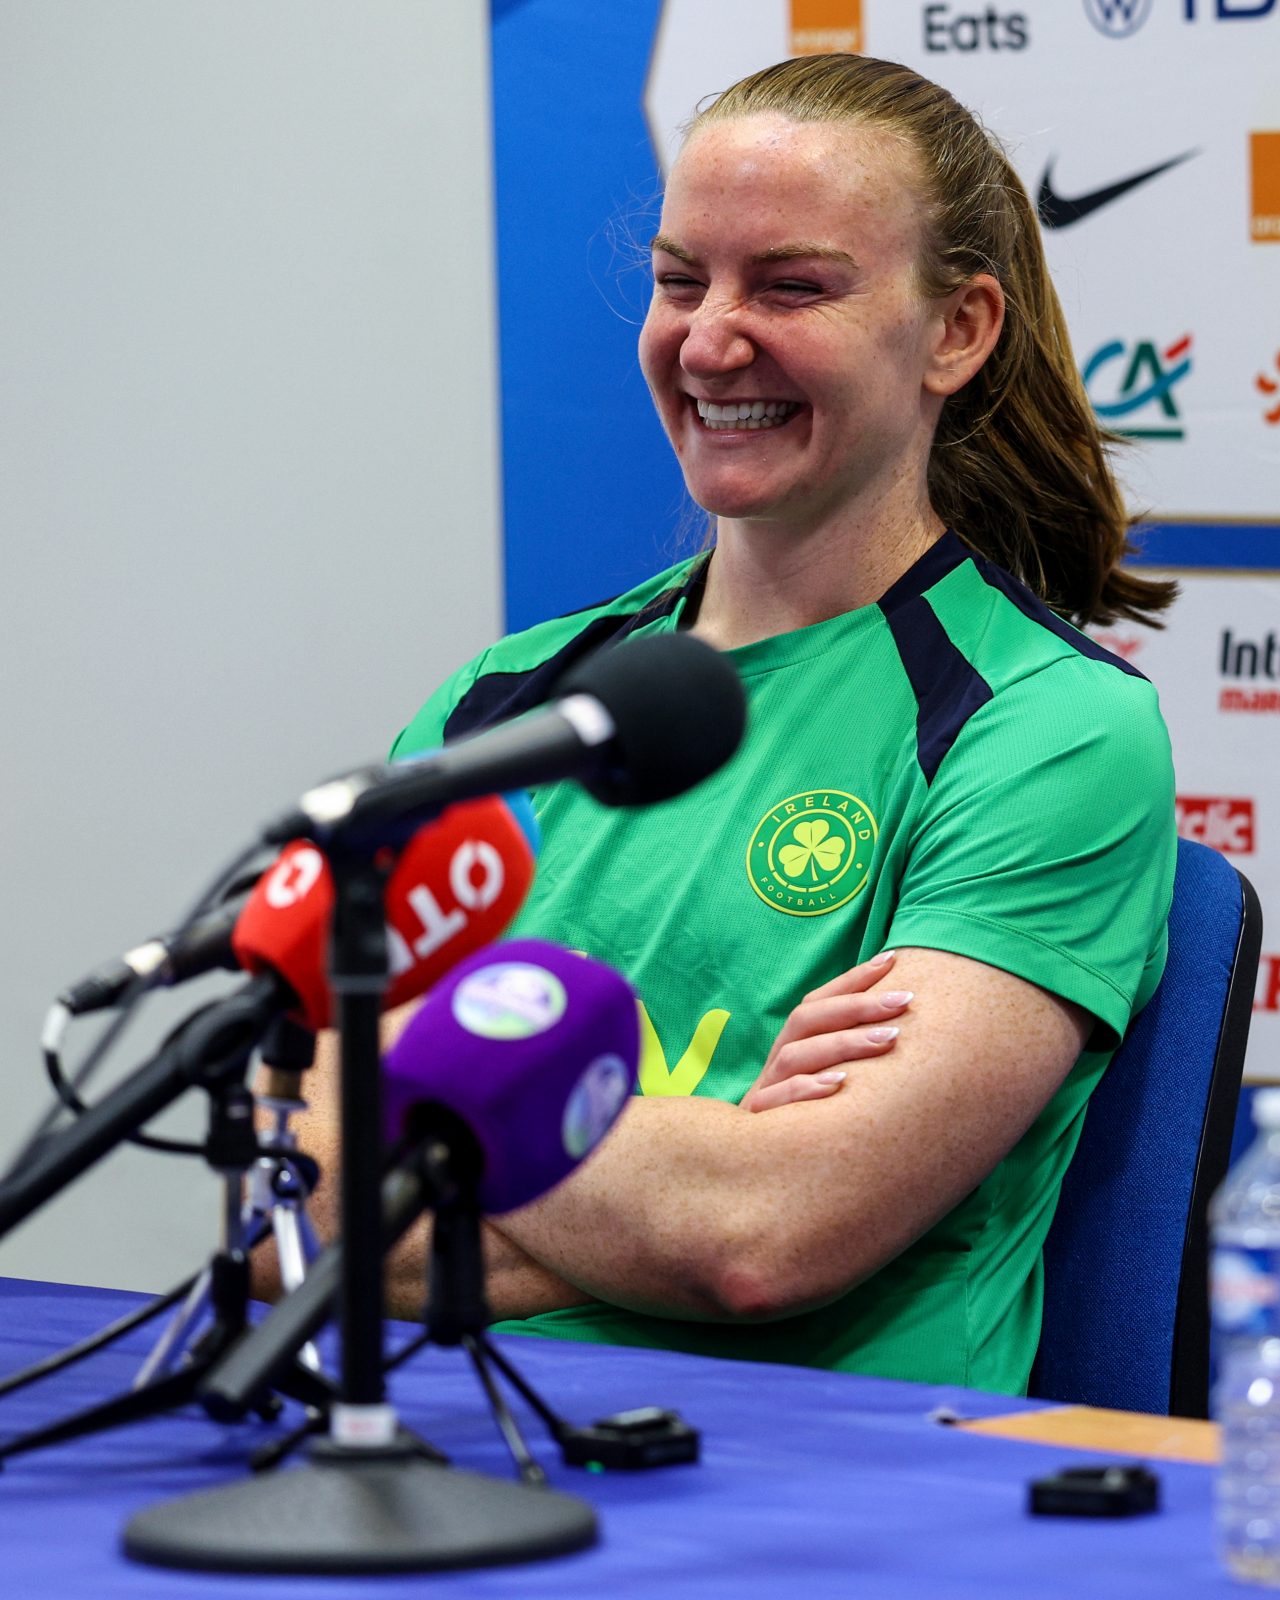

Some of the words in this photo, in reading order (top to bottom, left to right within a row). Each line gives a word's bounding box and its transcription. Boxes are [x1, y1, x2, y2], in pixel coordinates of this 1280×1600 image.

[923, 4, 1029, 52] Eats
[771, 795, 871, 841] IRELAND
[760, 876, 837, 906] FOOTBALL
